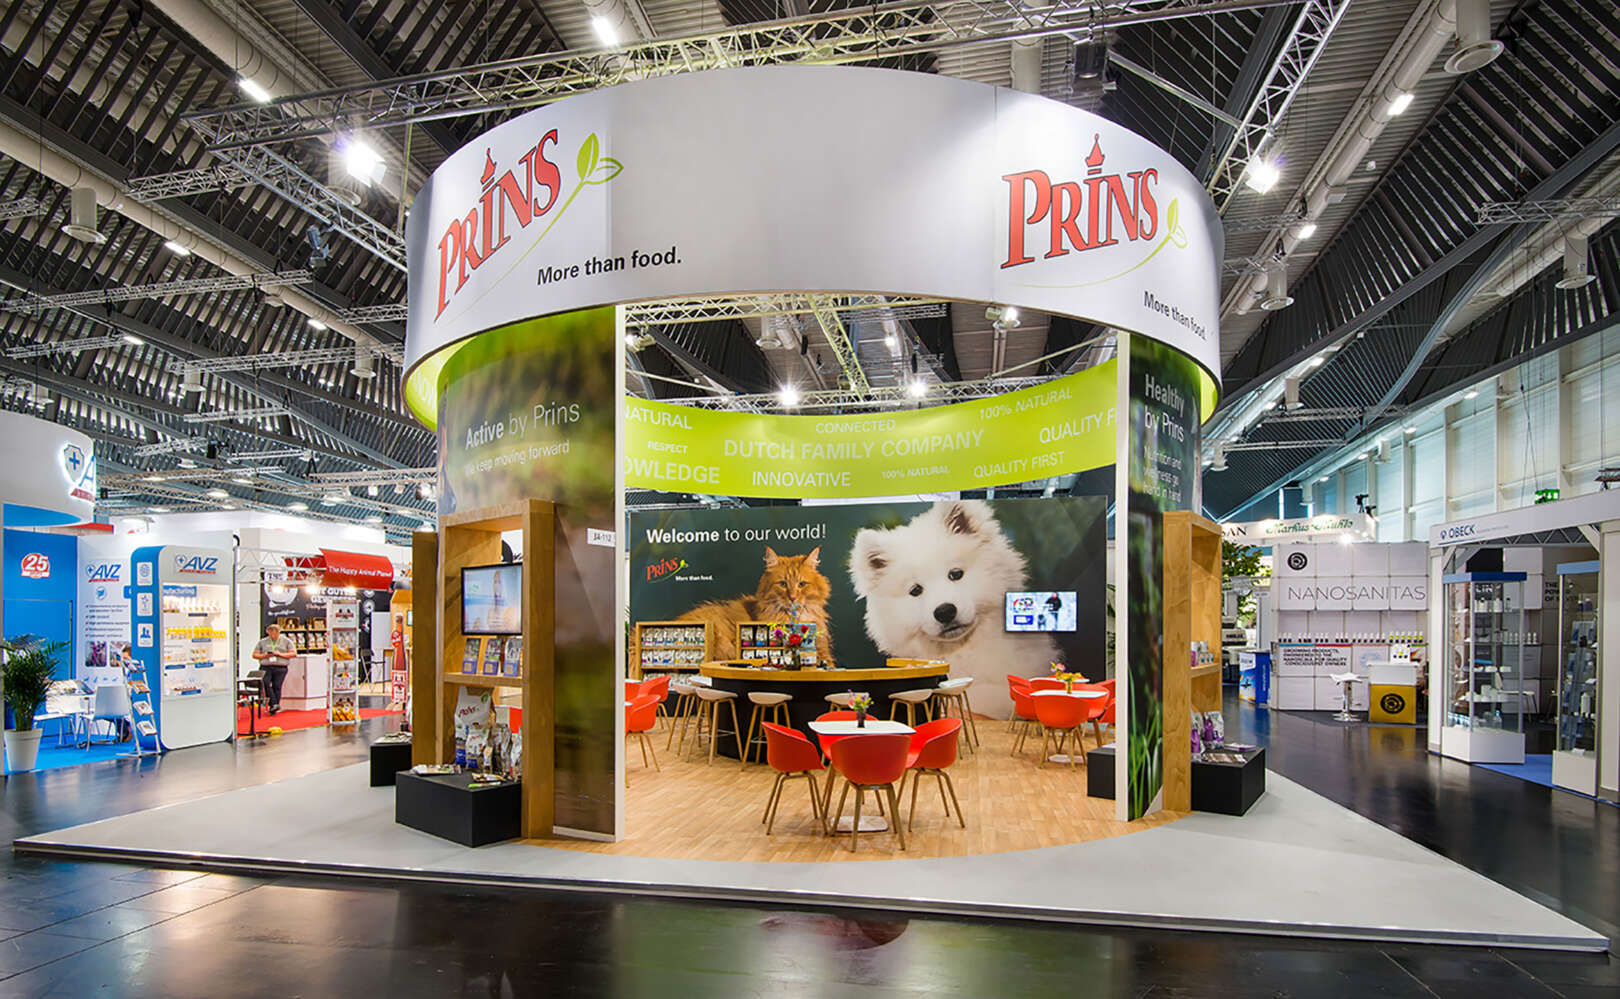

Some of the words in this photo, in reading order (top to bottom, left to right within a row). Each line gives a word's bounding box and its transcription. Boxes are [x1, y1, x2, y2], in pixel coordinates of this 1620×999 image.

[1000, 133, 1158, 269] PRINS
[434, 128, 561, 323] PRINS
[537, 266, 579, 286] More
[584, 256, 625, 276] than
[631, 246, 682, 268] food.
[1143, 290, 1170, 317] More
[1171, 306, 1190, 329] than
[979, 405, 1012, 420] 100%
[1016, 387, 1072, 412] NATURAL
[1144, 374, 1185, 418] Healthy
[465, 420, 504, 451] Active
[508, 413, 528, 438] by
[533, 401, 580, 429] Prins
[816, 418, 896, 434] CONNECTED
[1039, 410, 1104, 444] QUALITY
[1144, 405, 1160, 432] by
[1162, 412, 1185, 443] Prins
[476, 458, 493, 472] keep
[494, 449, 526, 465] moving
[528, 439, 569, 460] forward
[648, 440, 688, 454] RESPECT
[724, 439, 794, 459] DUTCH
[801, 441, 874, 459] FAMILY
[881, 429, 984, 457] COMPANY
[752, 471, 851, 487] INNOVATIVE
[907, 465, 949, 477] NATURAL
[973, 458, 1029, 479] QUALITY
[1031, 451, 1064, 469] FIRST
[646, 527, 719, 544] Welcome
[724, 527, 740, 542] to
[744, 527, 771, 541] our
[775, 524, 827, 540] world!
[25, 555, 48, 571] 25
[91, 564, 122, 579] AVZ
[183, 556, 218, 571] AVZ
[1288, 585, 1426, 601] NANOSANITAS
